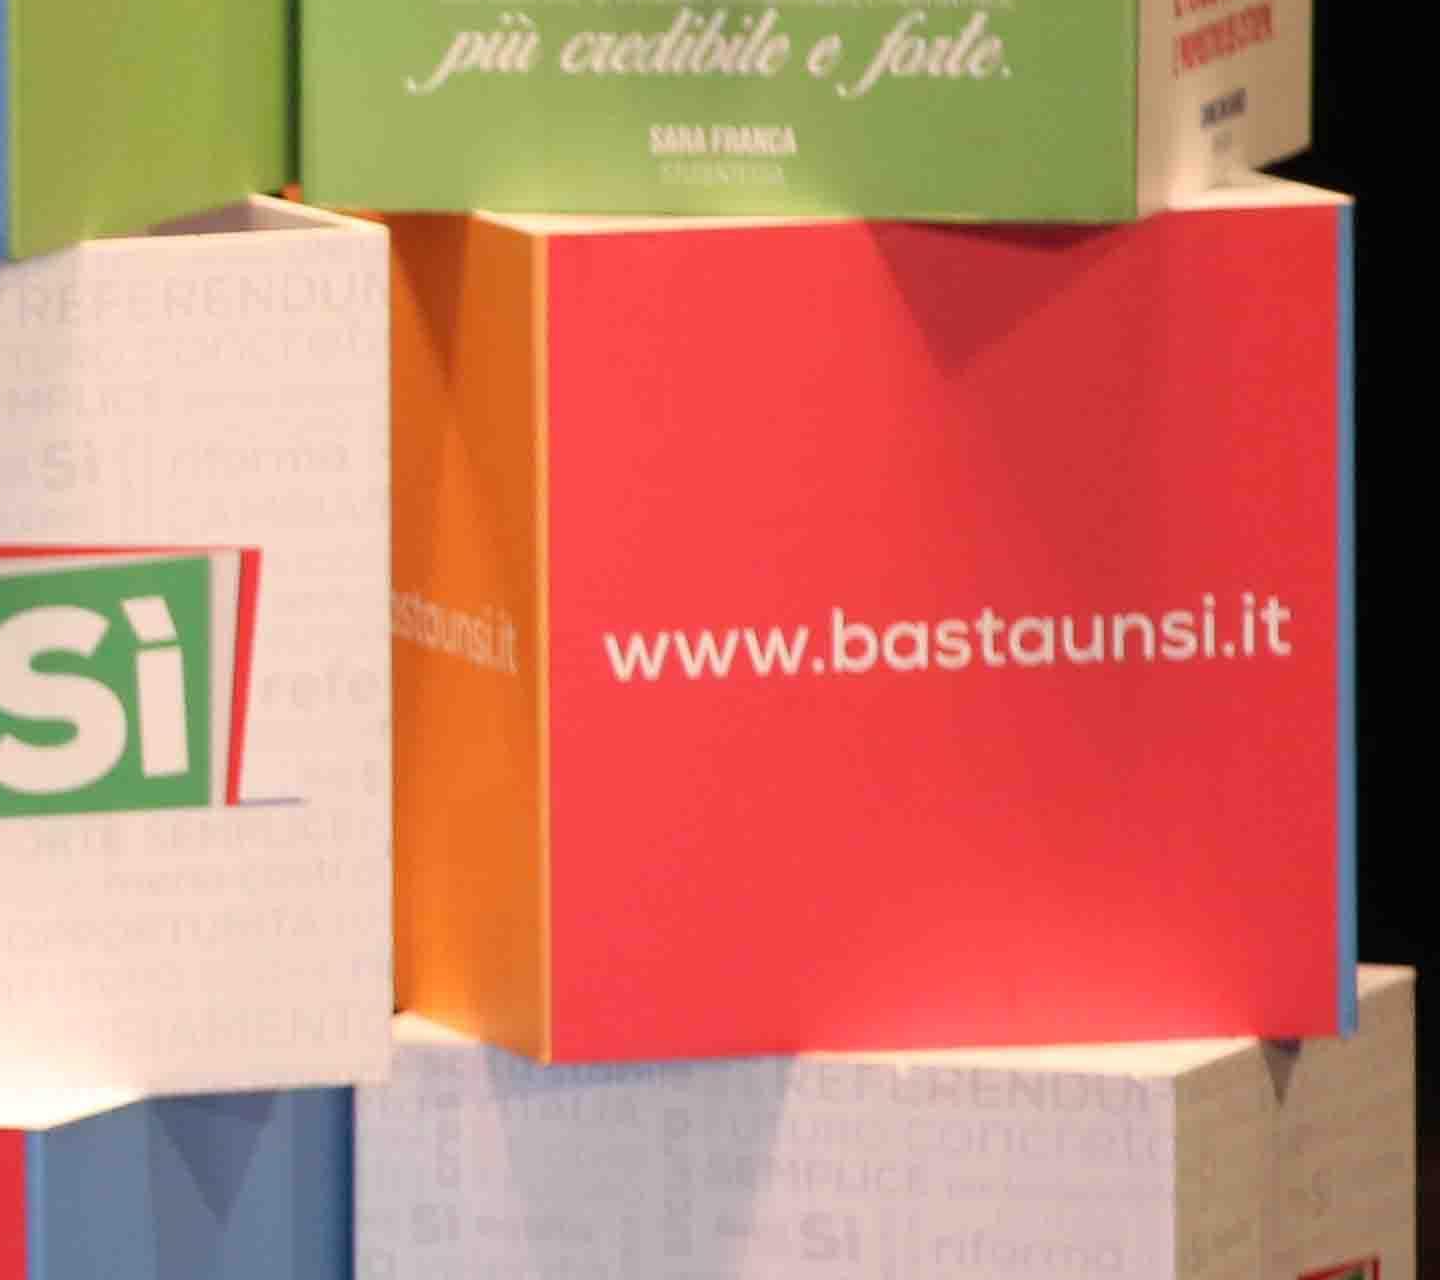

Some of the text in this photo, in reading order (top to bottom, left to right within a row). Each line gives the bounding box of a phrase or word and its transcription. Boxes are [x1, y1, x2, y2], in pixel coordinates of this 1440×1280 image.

[404, 7, 1014, 99] più credibile e forte.
[602, 591, 1293, 684] www.bastaunsi.it
